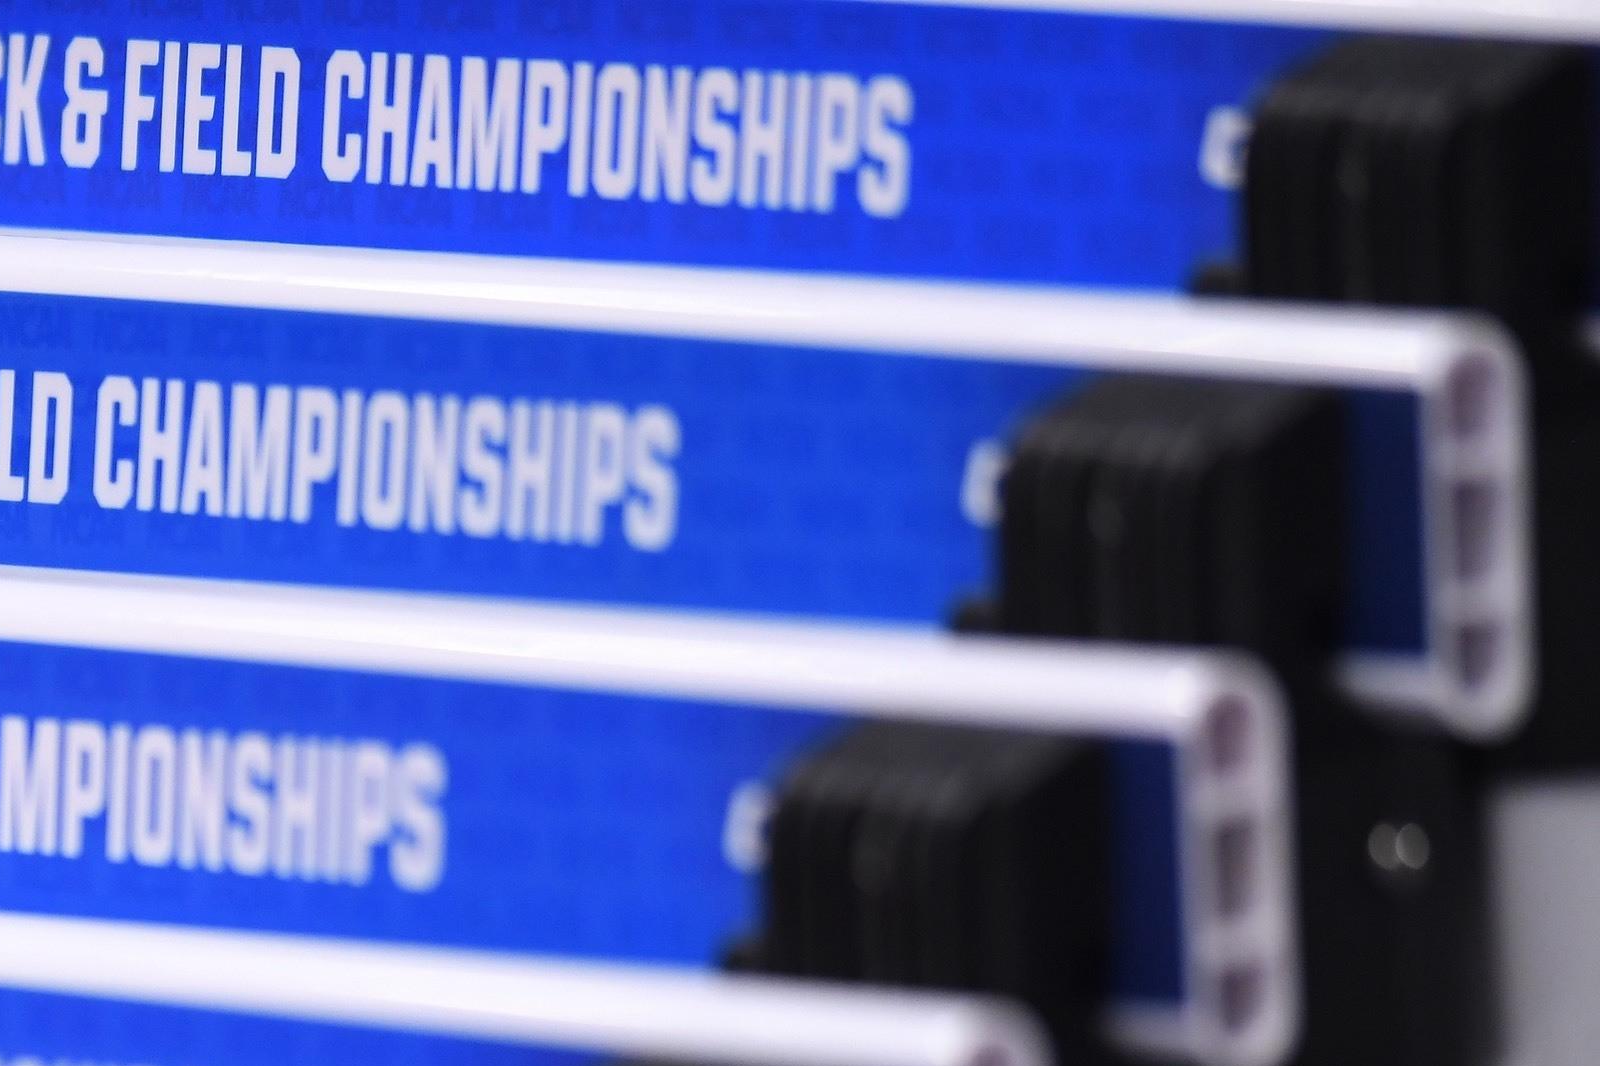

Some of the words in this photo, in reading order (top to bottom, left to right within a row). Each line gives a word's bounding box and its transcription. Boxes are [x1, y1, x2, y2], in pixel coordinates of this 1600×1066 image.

[60, 36, 109, 169] &
[121, 39, 301, 179] FIELD
[321, 50, 910, 215] CHAMPIONSHIPS
[93, 376, 677, 552] CHAMPIONSHIPS
